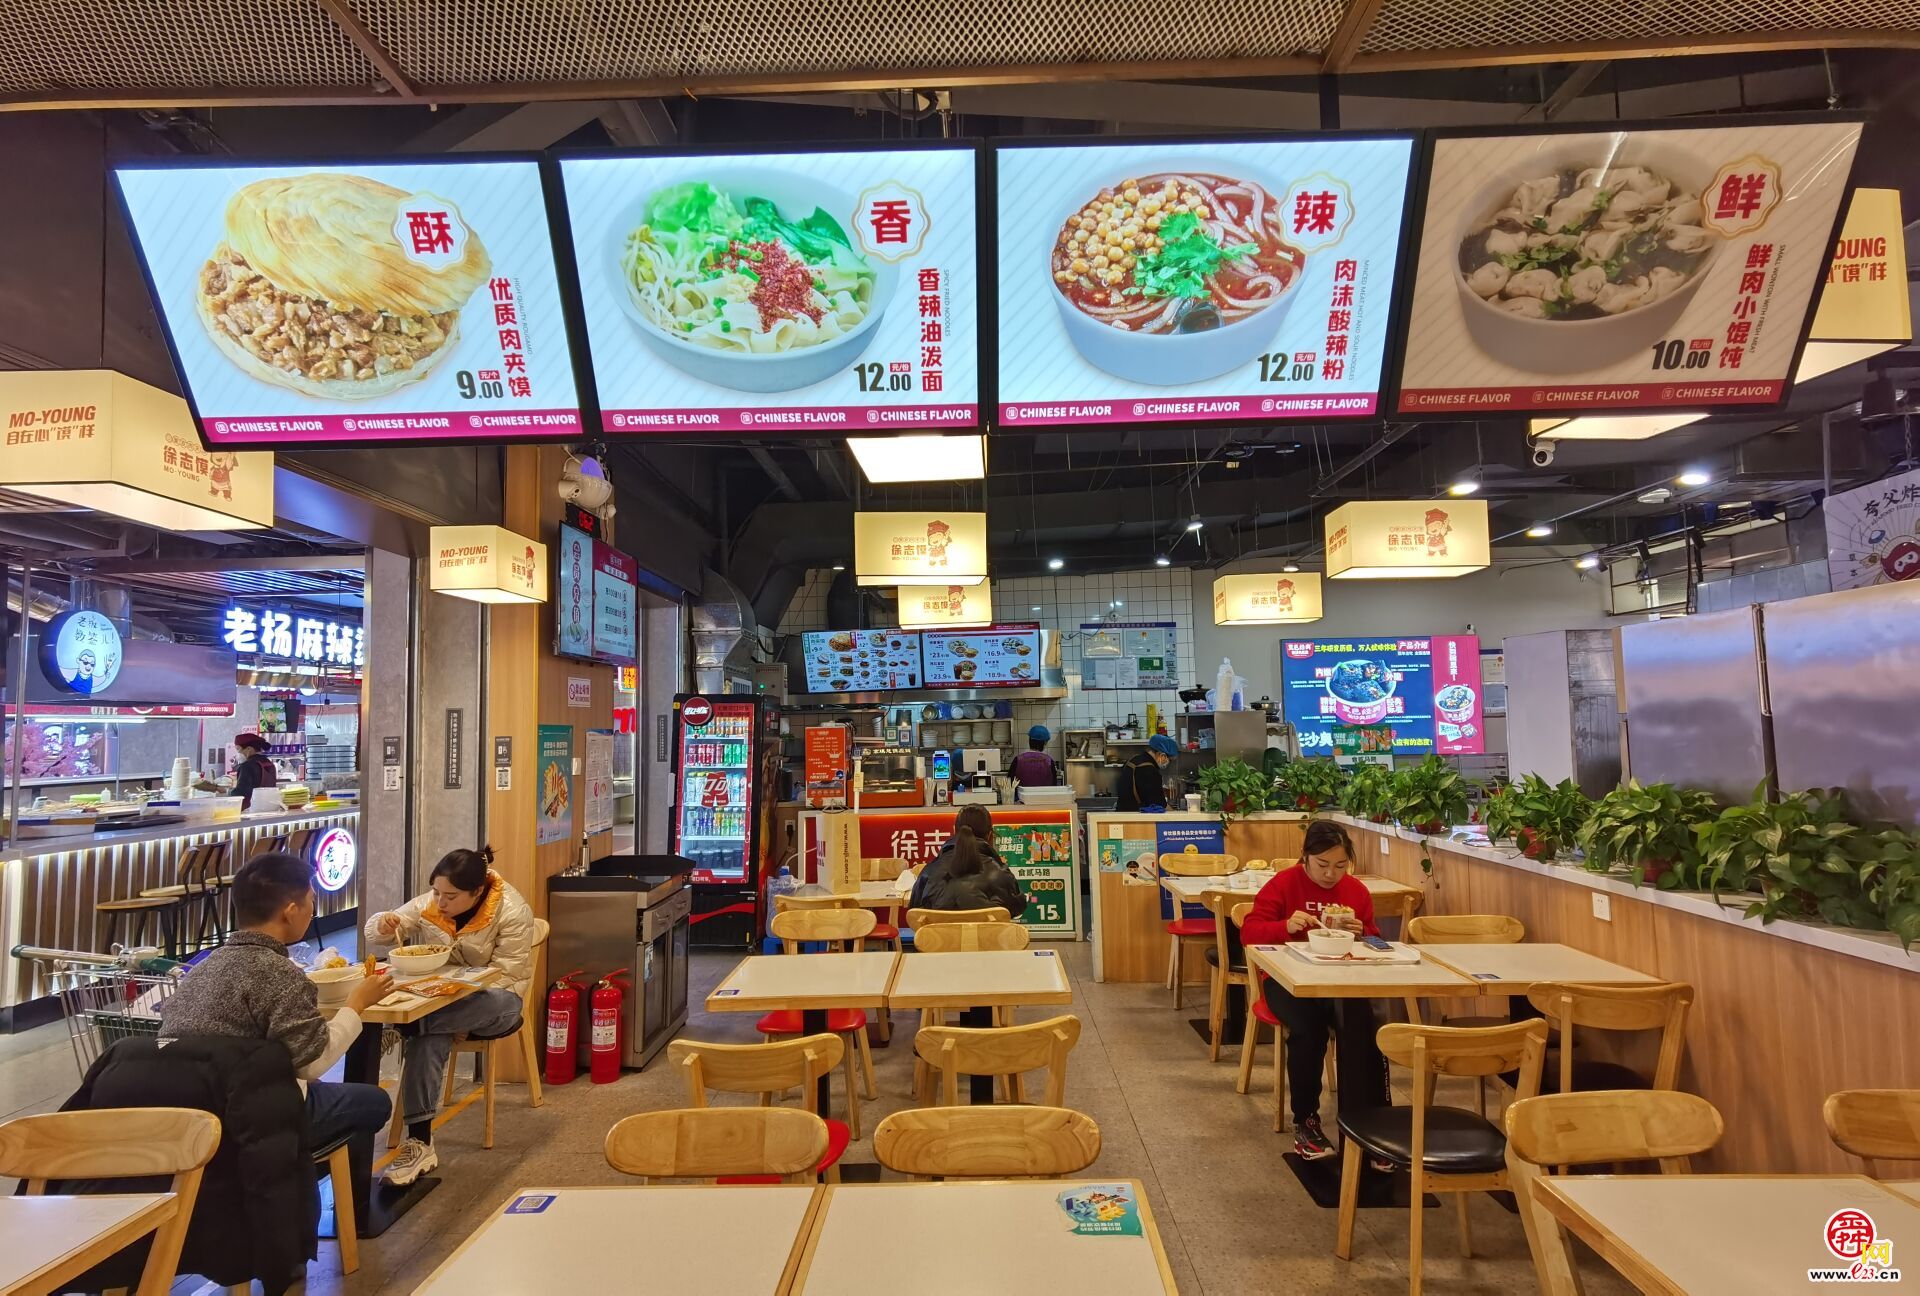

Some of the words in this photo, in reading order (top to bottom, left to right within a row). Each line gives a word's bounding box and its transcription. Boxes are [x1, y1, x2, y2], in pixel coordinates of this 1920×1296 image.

[1714, 174, 1767, 221] 鲜
[1293, 191, 1338, 235] 辣
[870, 199, 911, 244] 香
[406, 211, 454, 254] 酥
[1361, 259, 1370, 285] MINCED
[1766, 266, 1779, 298] WONTON
[1720, 244, 1773, 369] 鲜肉小馄饨
[1322, 258, 1357, 380] 肉沫酸辣粉
[918, 267, 942, 392] 香辣油泼面
[489, 277, 532, 398] 优质肉夹馍
[1651, 340, 1711, 370] 10.00
[480, 371, 498, 379] 元/个
[890, 363, 911, 372] 元/份
[1257, 353, 1314, 382] 12.00
[456, 370, 504, 399] 9.00
[853, 362, 912, 392] 12.00
[1418, 394, 1466, 404] CHINESE
[1468, 393, 1511, 403] FLAVOR
[1547, 391, 1594, 402] CHINESE
[1597, 390, 1640, 401] FLAVOR
[1677, 388, 1726, 399] CHINESE
[1727, 387, 1772, 397] FLAVOR
[1020, 407, 1067, 418] CHINESE
[1069, 406, 1112, 417] FLAVOR
[1147, 403, 1195, 414] CHINESE
[1197, 402, 1241, 413] FLAVOR
[1276, 399, 1323, 411] CHINESE
[1326, 398, 1369, 409] FLAVOR
[8, 405, 97, 428] MO-YOUNG
[484, 416, 531, 427] CHINESE
[533, 415, 576, 425] FLAVOR
[627, 415, 675, 425] CHINESE
[677, 414, 720, 424] FLAVOR
[754, 413, 802, 424] CHINESE
[804, 412, 846, 423] FLAVOR
[881, 411, 927, 421] CHINESE
[930, 410, 972, 420] FLAVOR
[229, 421, 278, 433] CHINESE
[280, 420, 323, 432] FLAVOR
[358, 418, 404, 430] CHINESE
[406, 417, 450, 428] FLAVOR
[164, 445, 209, 476] 徐志馍
[1388, 534, 1425, 546] 徐志馍
[440, 545, 488, 559] MO-YOUNG
[891, 544, 927, 556] 徐志馍
[1399, 641, 1429, 650] 产品介绍
[891, 829, 951, 860] 徐志
[1036, 904, 1059, 920] 15
